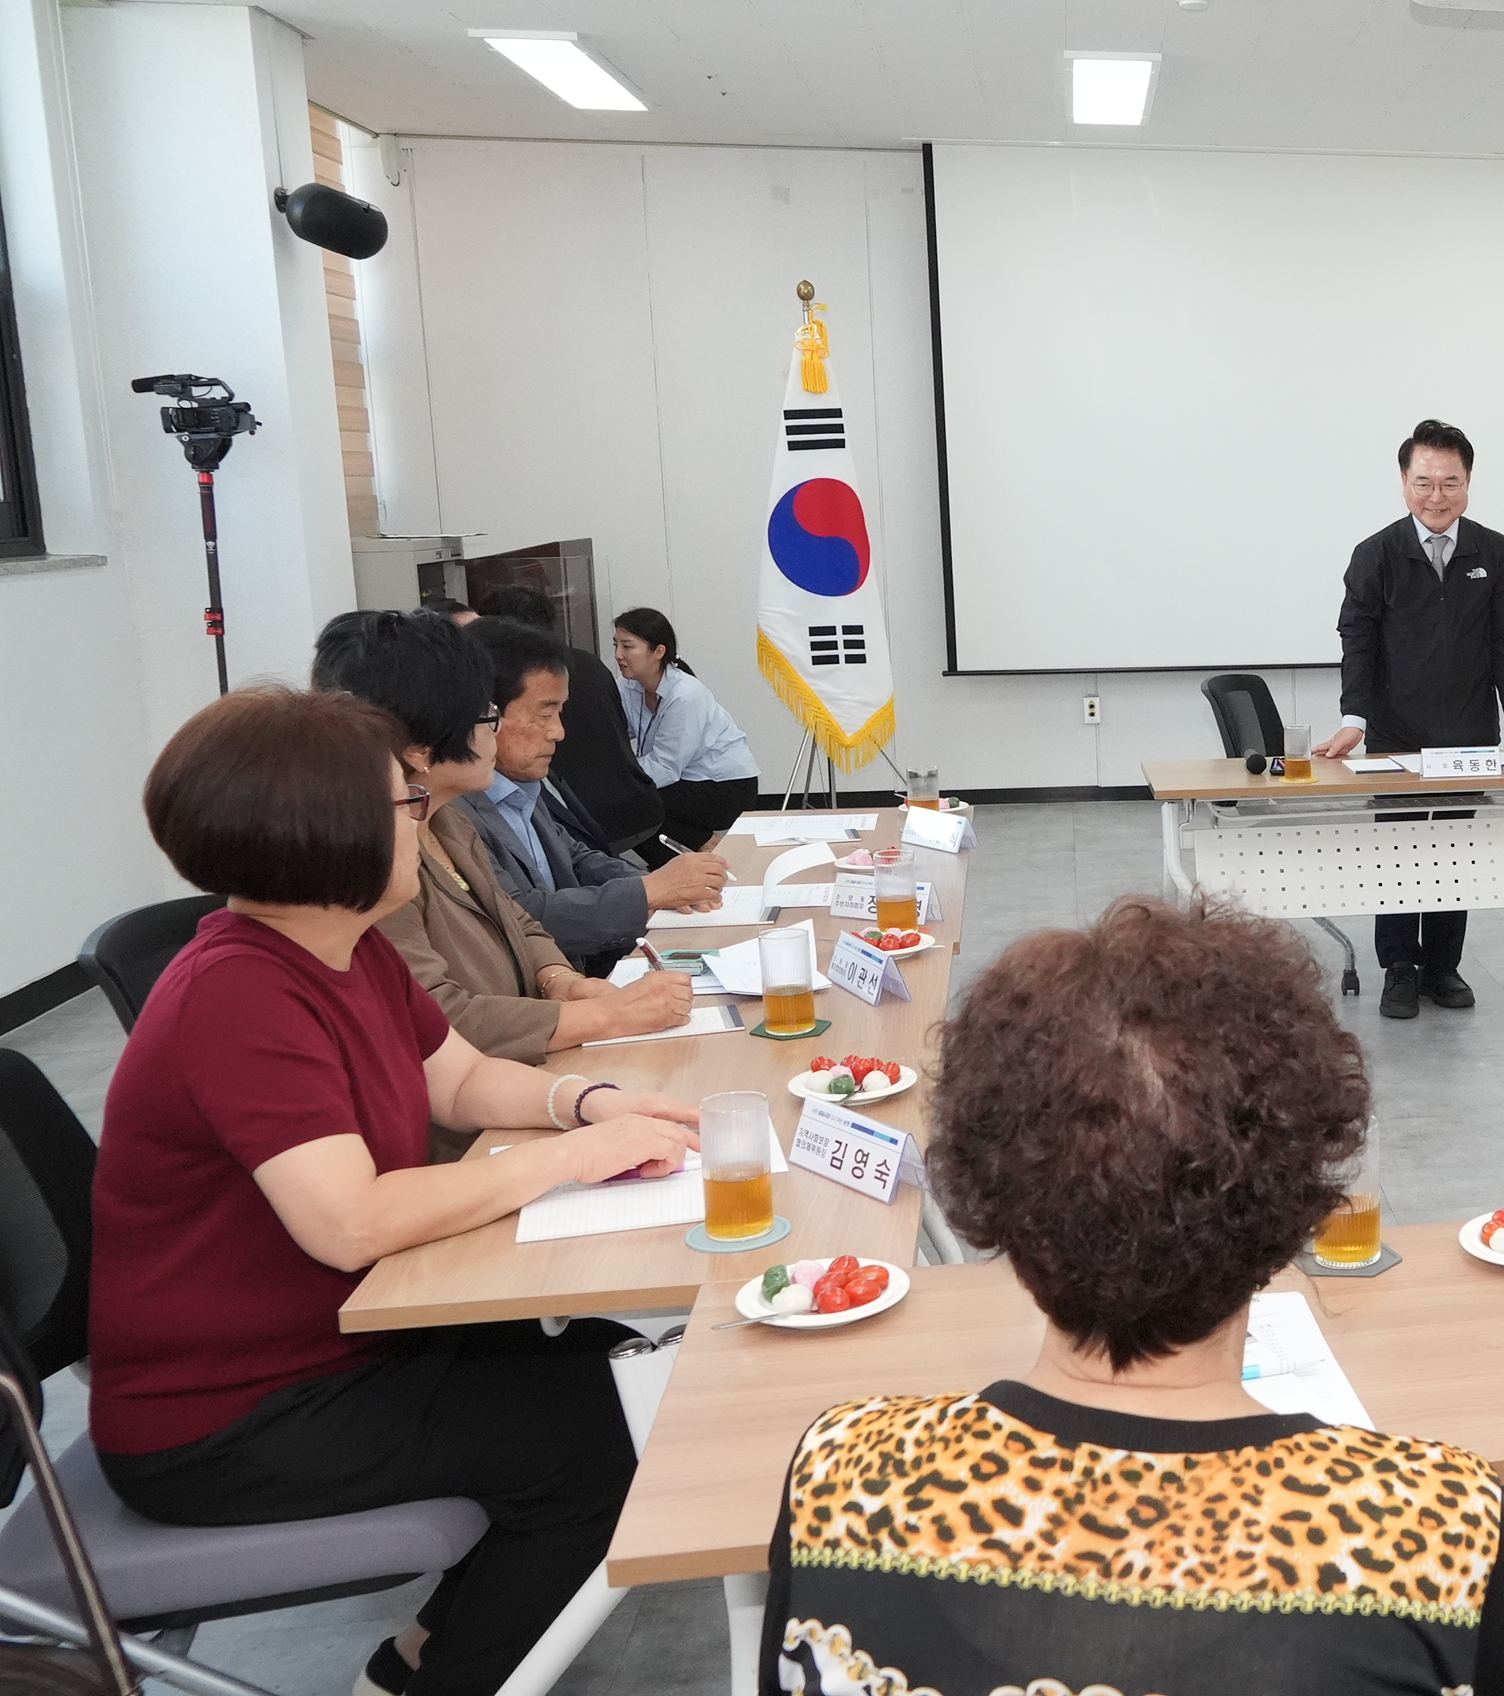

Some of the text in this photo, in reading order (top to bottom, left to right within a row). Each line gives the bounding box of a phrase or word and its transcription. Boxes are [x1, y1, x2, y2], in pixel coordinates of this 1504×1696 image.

[1453, 759, 1497, 772] 육동한
[847, 961, 879, 996] 이관선
[799, 1127, 830, 1148] 지역사회보장
[829, 1139, 891, 1190] 김영숙
